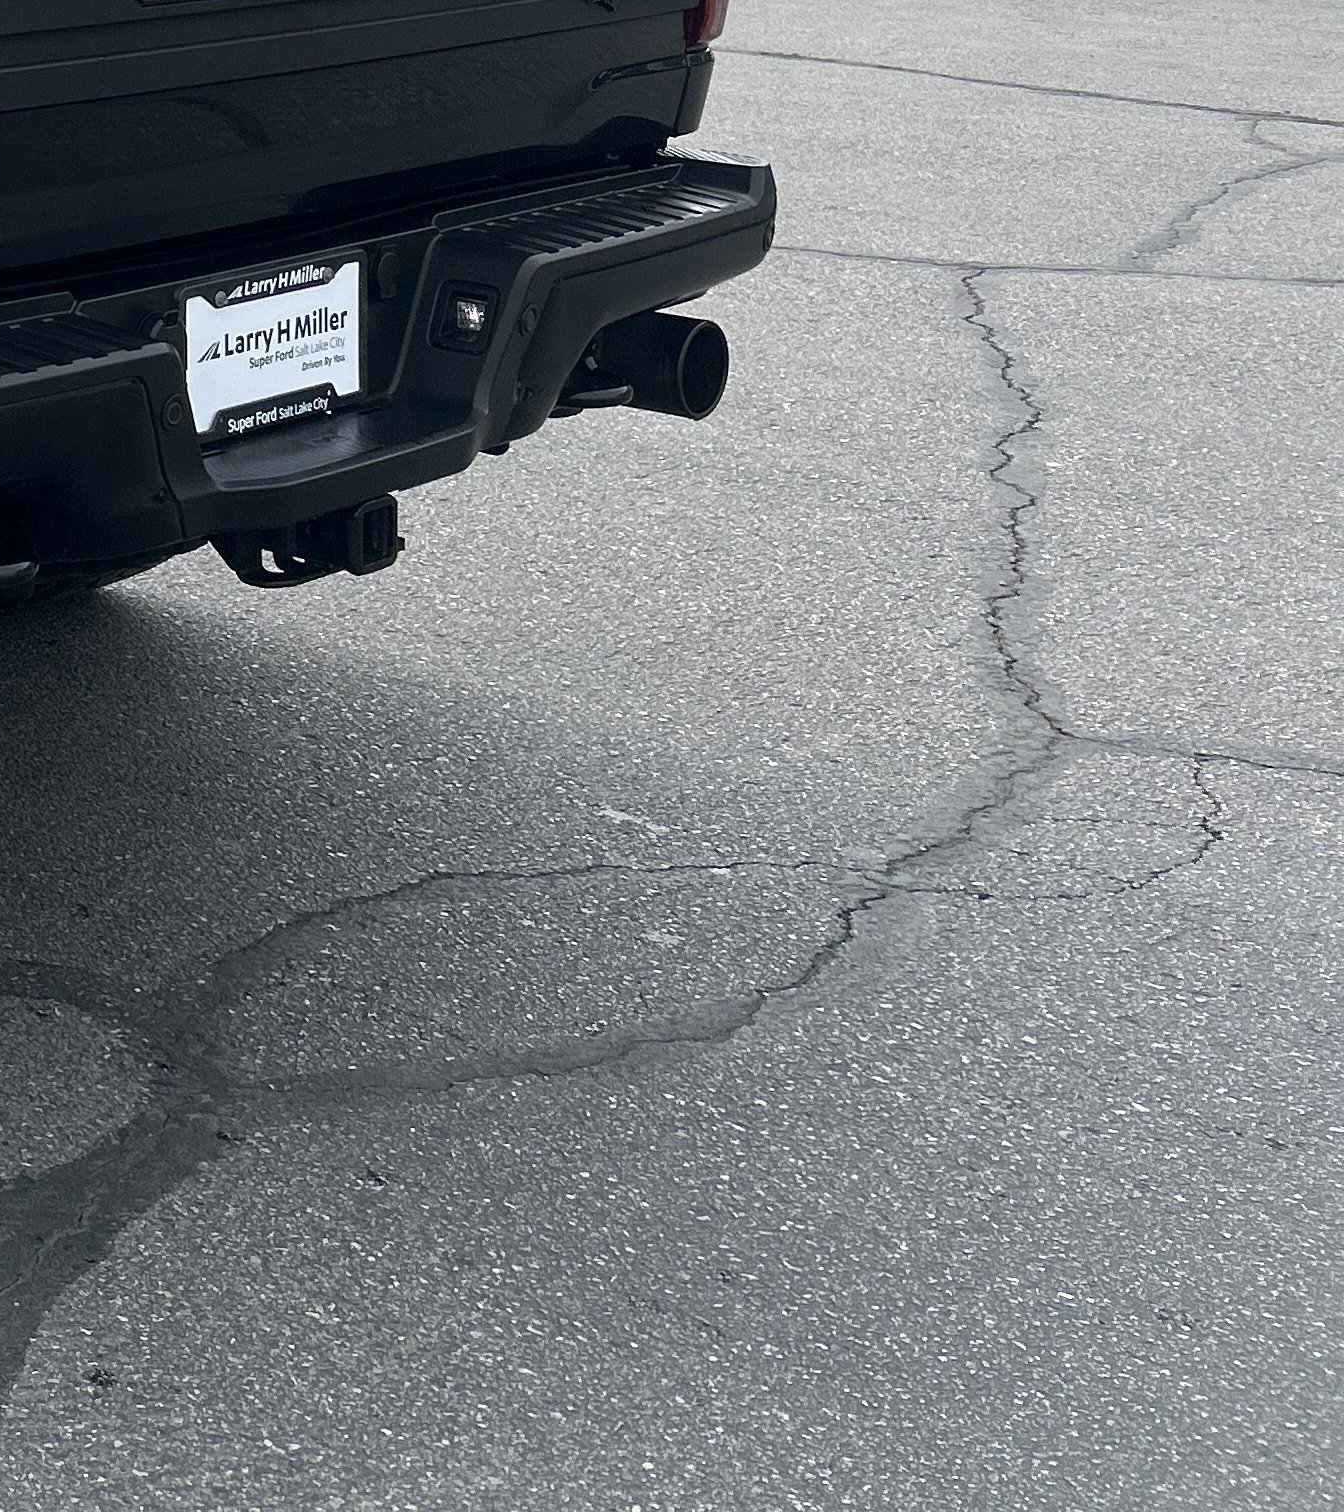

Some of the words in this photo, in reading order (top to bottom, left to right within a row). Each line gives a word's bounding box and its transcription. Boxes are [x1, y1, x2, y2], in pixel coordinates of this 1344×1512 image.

[244, 277, 278, 296] Larry
[278, 272, 288, 289] H
[290, 264, 325, 285] Miller
[224, 327, 274, 357] Larry
[277, 319, 291, 344] H
[295, 307, 348, 340] Miller
[249, 355, 274, 369] Super
[275, 346, 294, 362] Ford
[295, 343, 310, 357] Salt
[311, 339, 329, 354] Lake
[330, 336, 345, 349] City
[227, 415, 255, 434] Super
[255, 406, 277, 426] Ford
[279, 405, 294, 420] Salt
[294, 401, 312, 416] Lake
[313, 396, 329, 411] City
